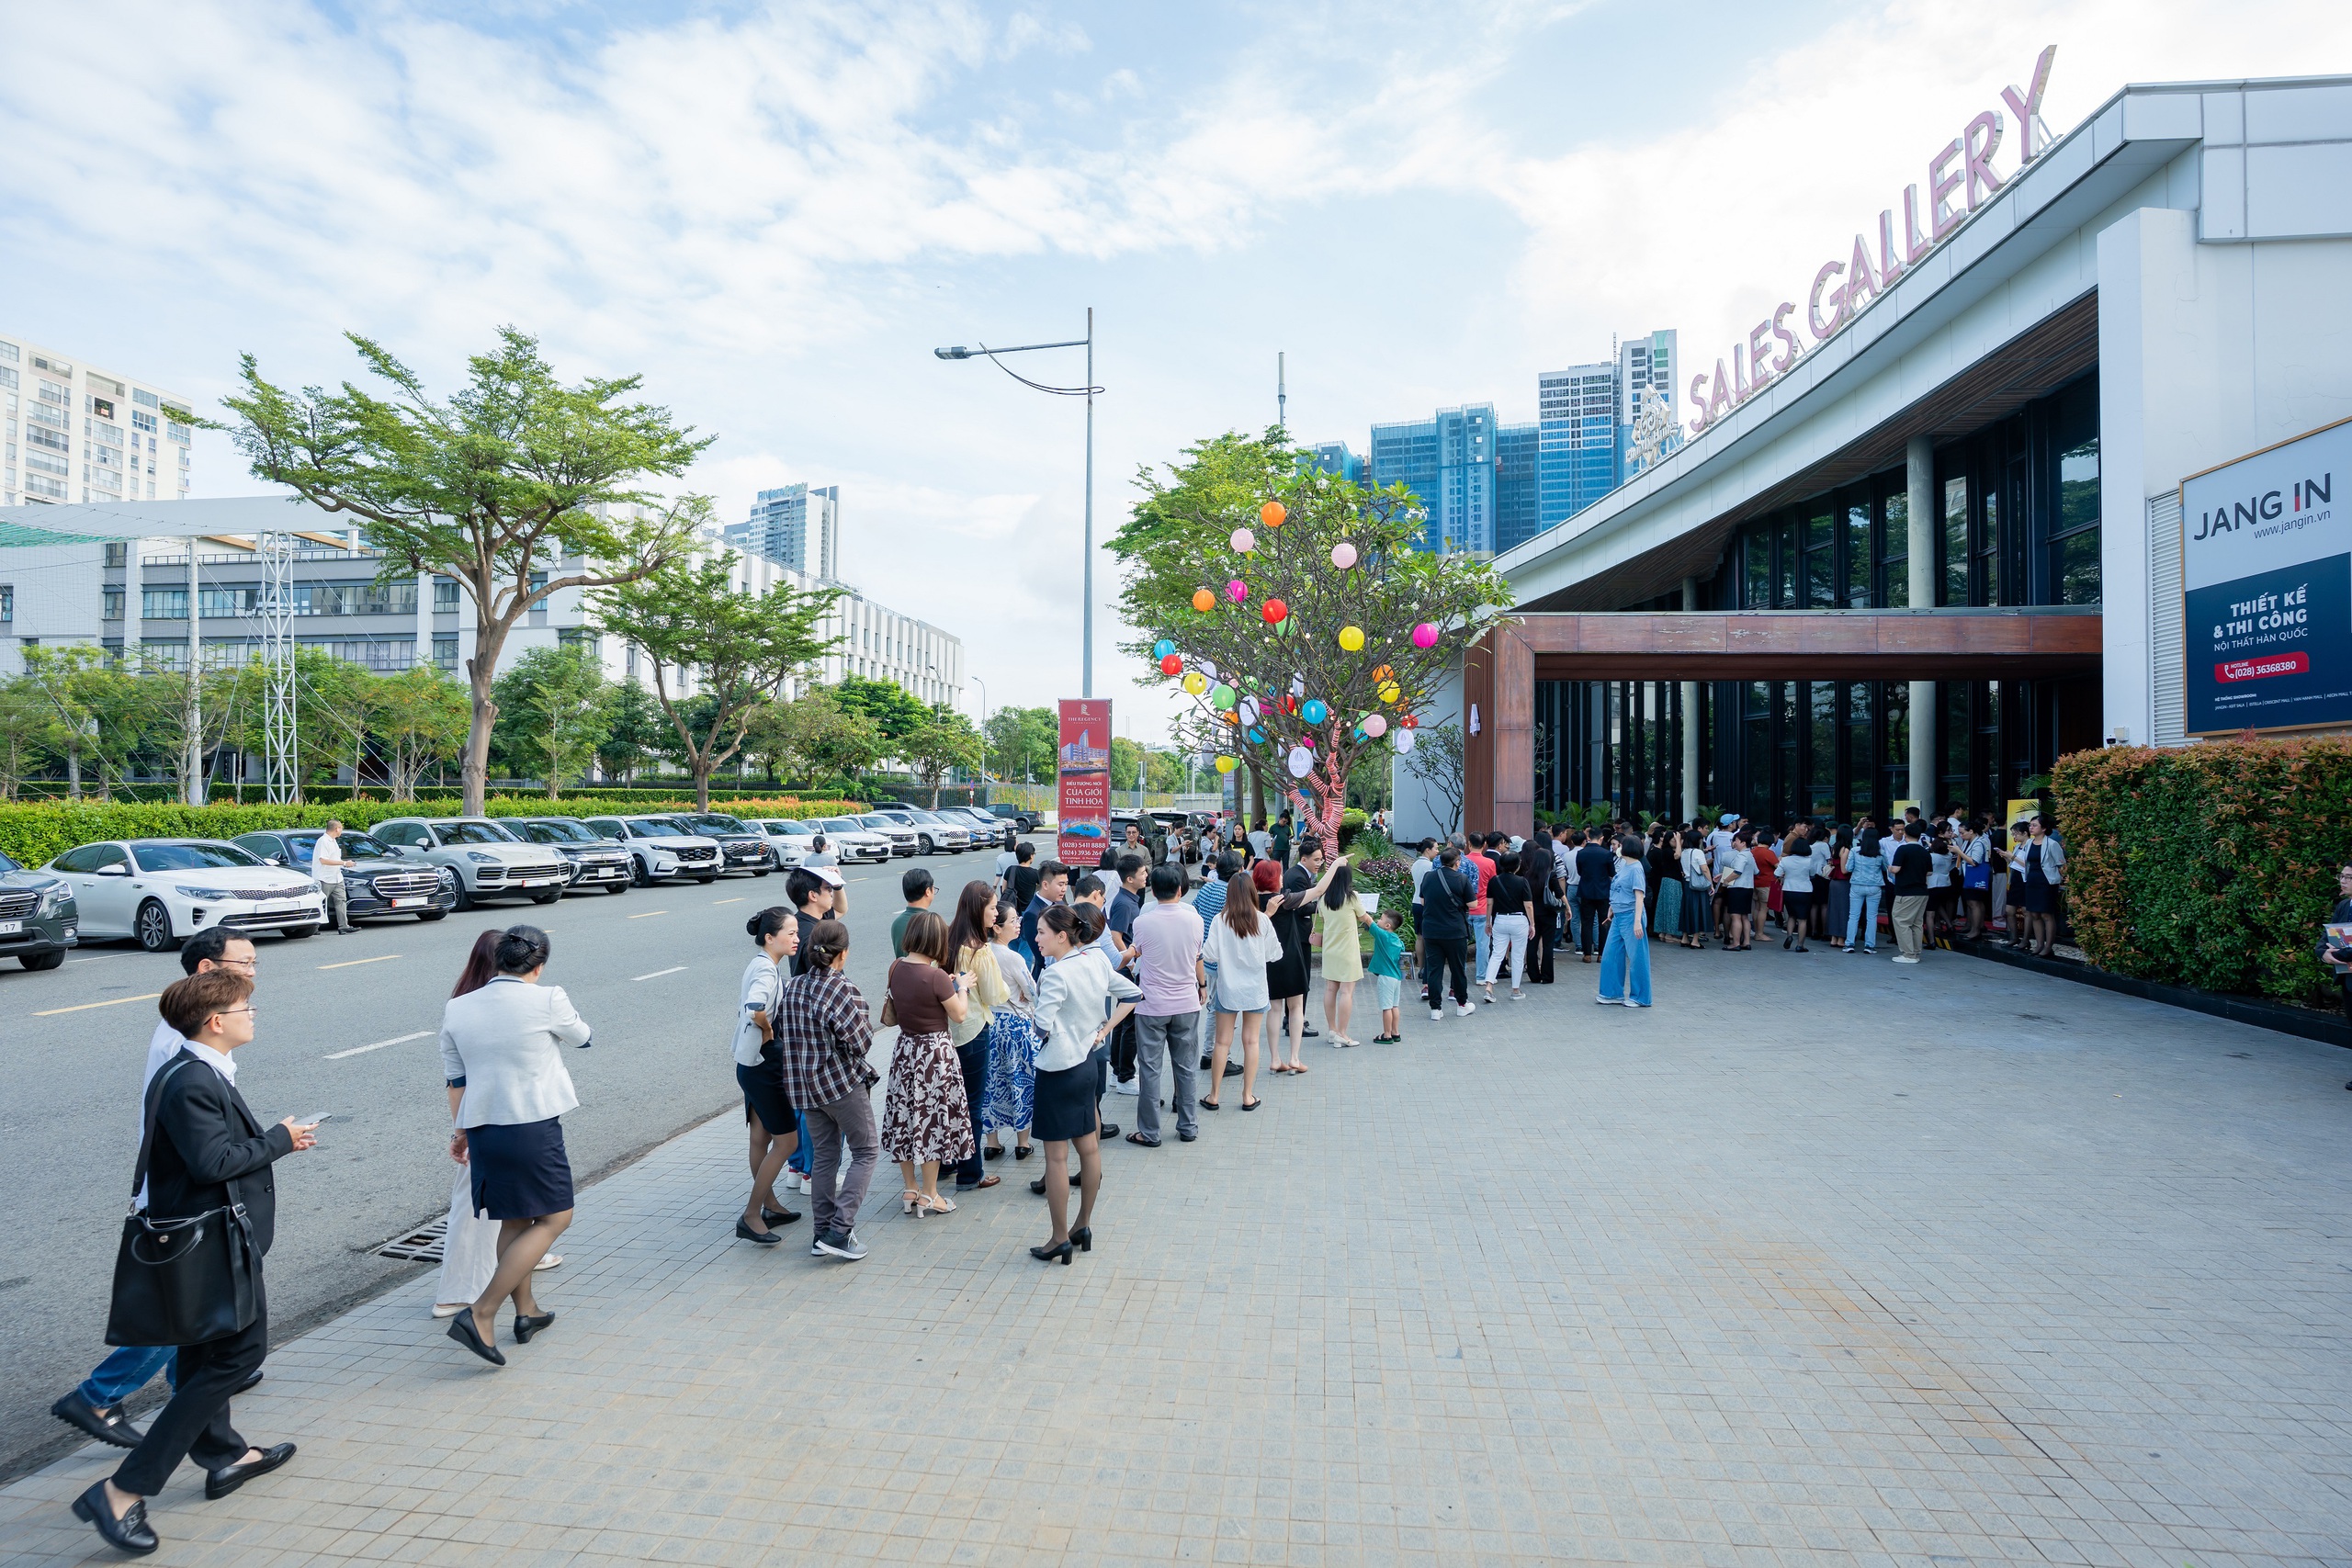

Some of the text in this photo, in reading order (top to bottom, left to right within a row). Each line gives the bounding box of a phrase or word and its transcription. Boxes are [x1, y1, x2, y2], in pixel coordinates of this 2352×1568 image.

[1690, 44, 2058, 433] SALES GALLERY
[2194, 472, 2331, 541] JANG IN
[2254, 510, 2331, 539] www.jangin.vn
[2231, 583, 2309, 617] THIẾT KẾ
[2213, 608, 2308, 638] & THI CÔNG
[2214, 626, 2308, 652] NỘI THẤT HÀN QUỐC
[2235, 660, 2297, 679] (028) 36368380
[1066, 786, 1102, 796] CỦA GIỚI
[1085, 797, 1103, 806] HOA
